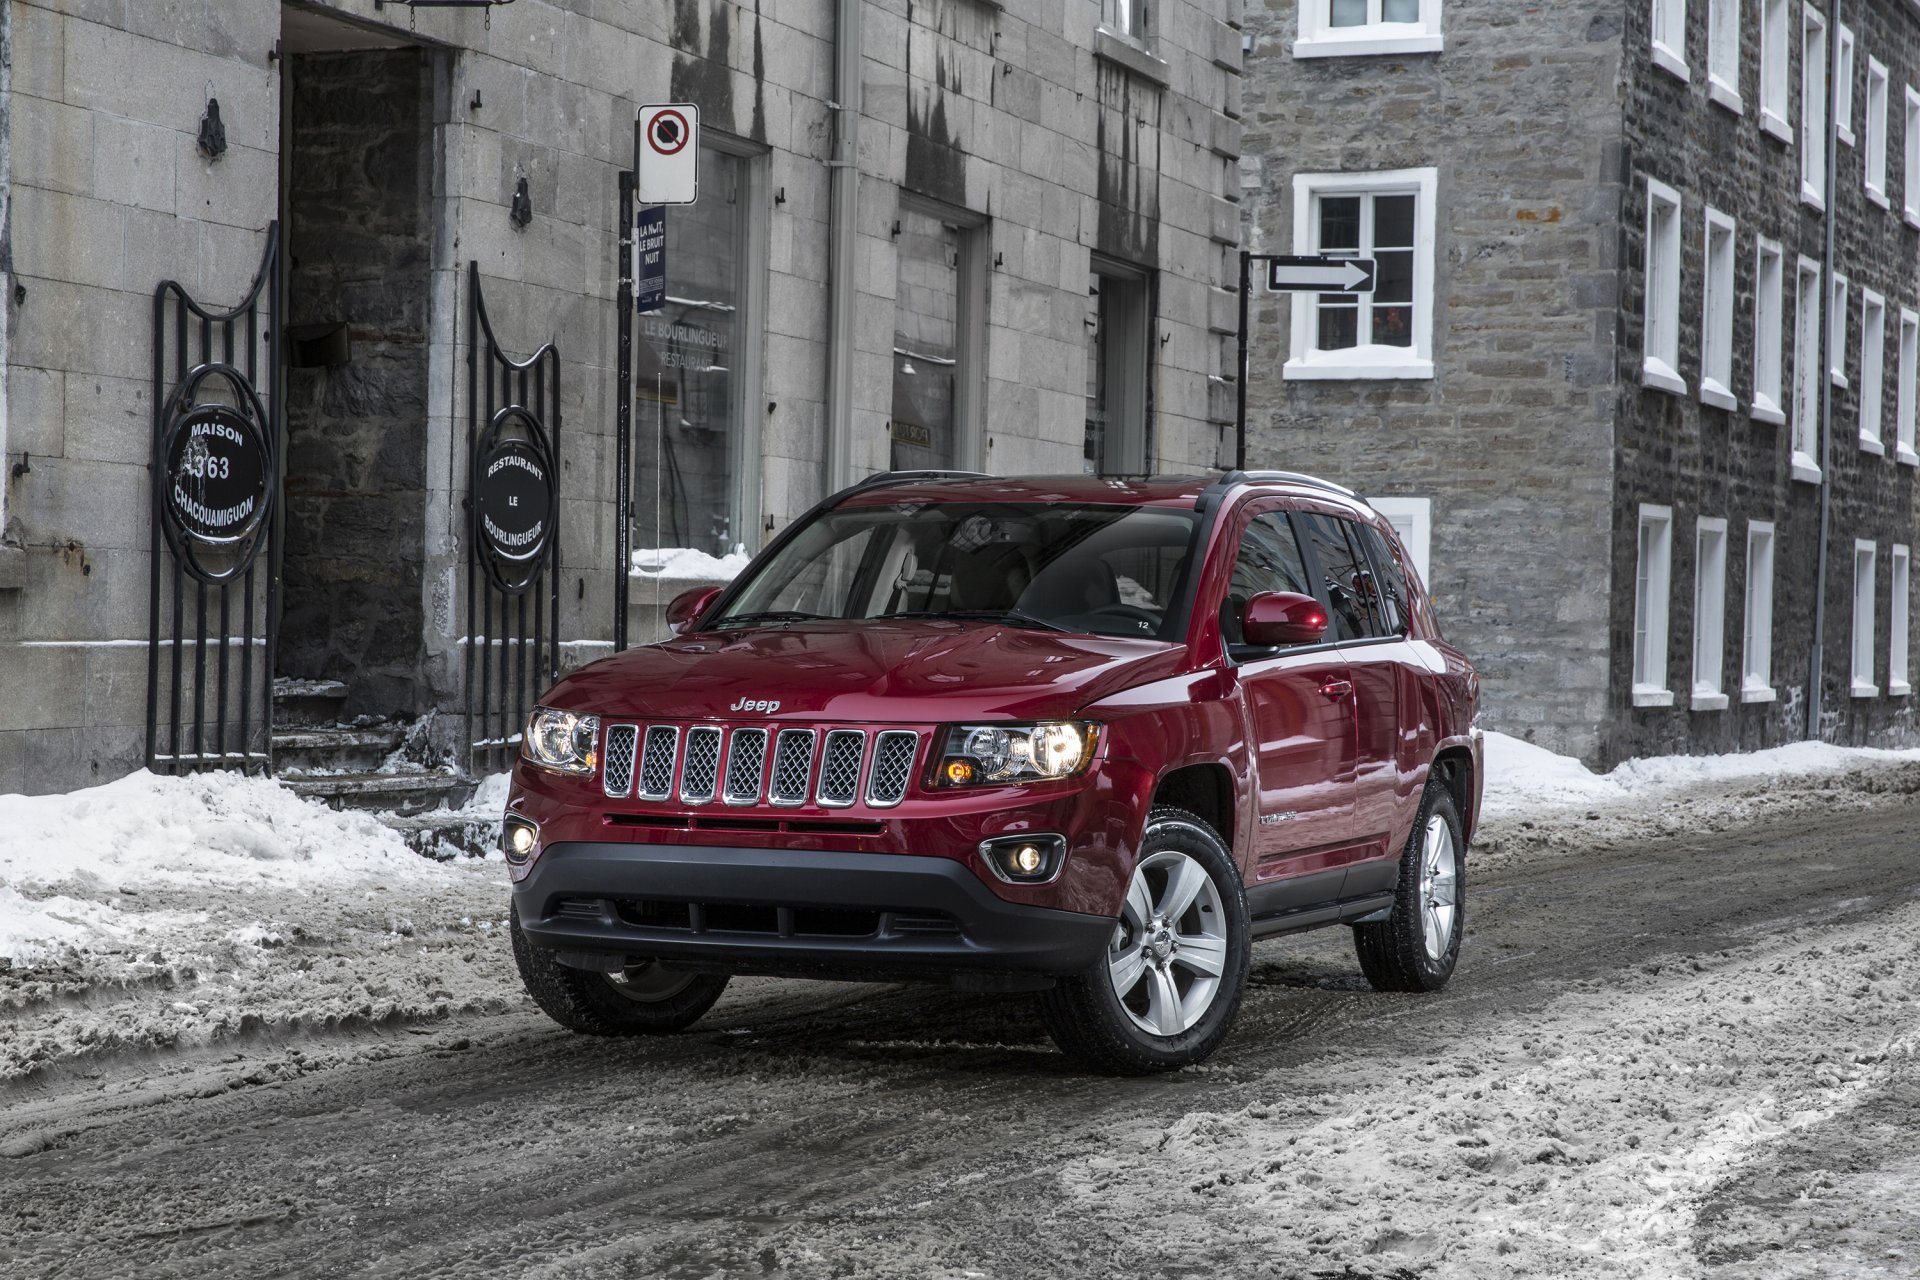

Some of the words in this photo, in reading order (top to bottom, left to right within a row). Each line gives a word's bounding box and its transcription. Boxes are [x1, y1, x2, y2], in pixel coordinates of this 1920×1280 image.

[640, 225, 648, 238] LA
[648, 221, 664, 236] NUIT,
[640, 240, 647, 252] LE
[646, 235, 664, 251] BRUIT
[645, 250, 660, 265] NUIT
[644, 320, 656, 337] LE
[191, 423, 243, 447] MAISON
[194, 455, 229, 479] 363
[487, 455, 543, 481] RESTAURANT
[508, 495, 518, 507] LE
[484, 513, 542, 546] BOURLINGUEUR
[1137, 620, 1149, 629] 12
[730, 696, 780, 714] Jeep
